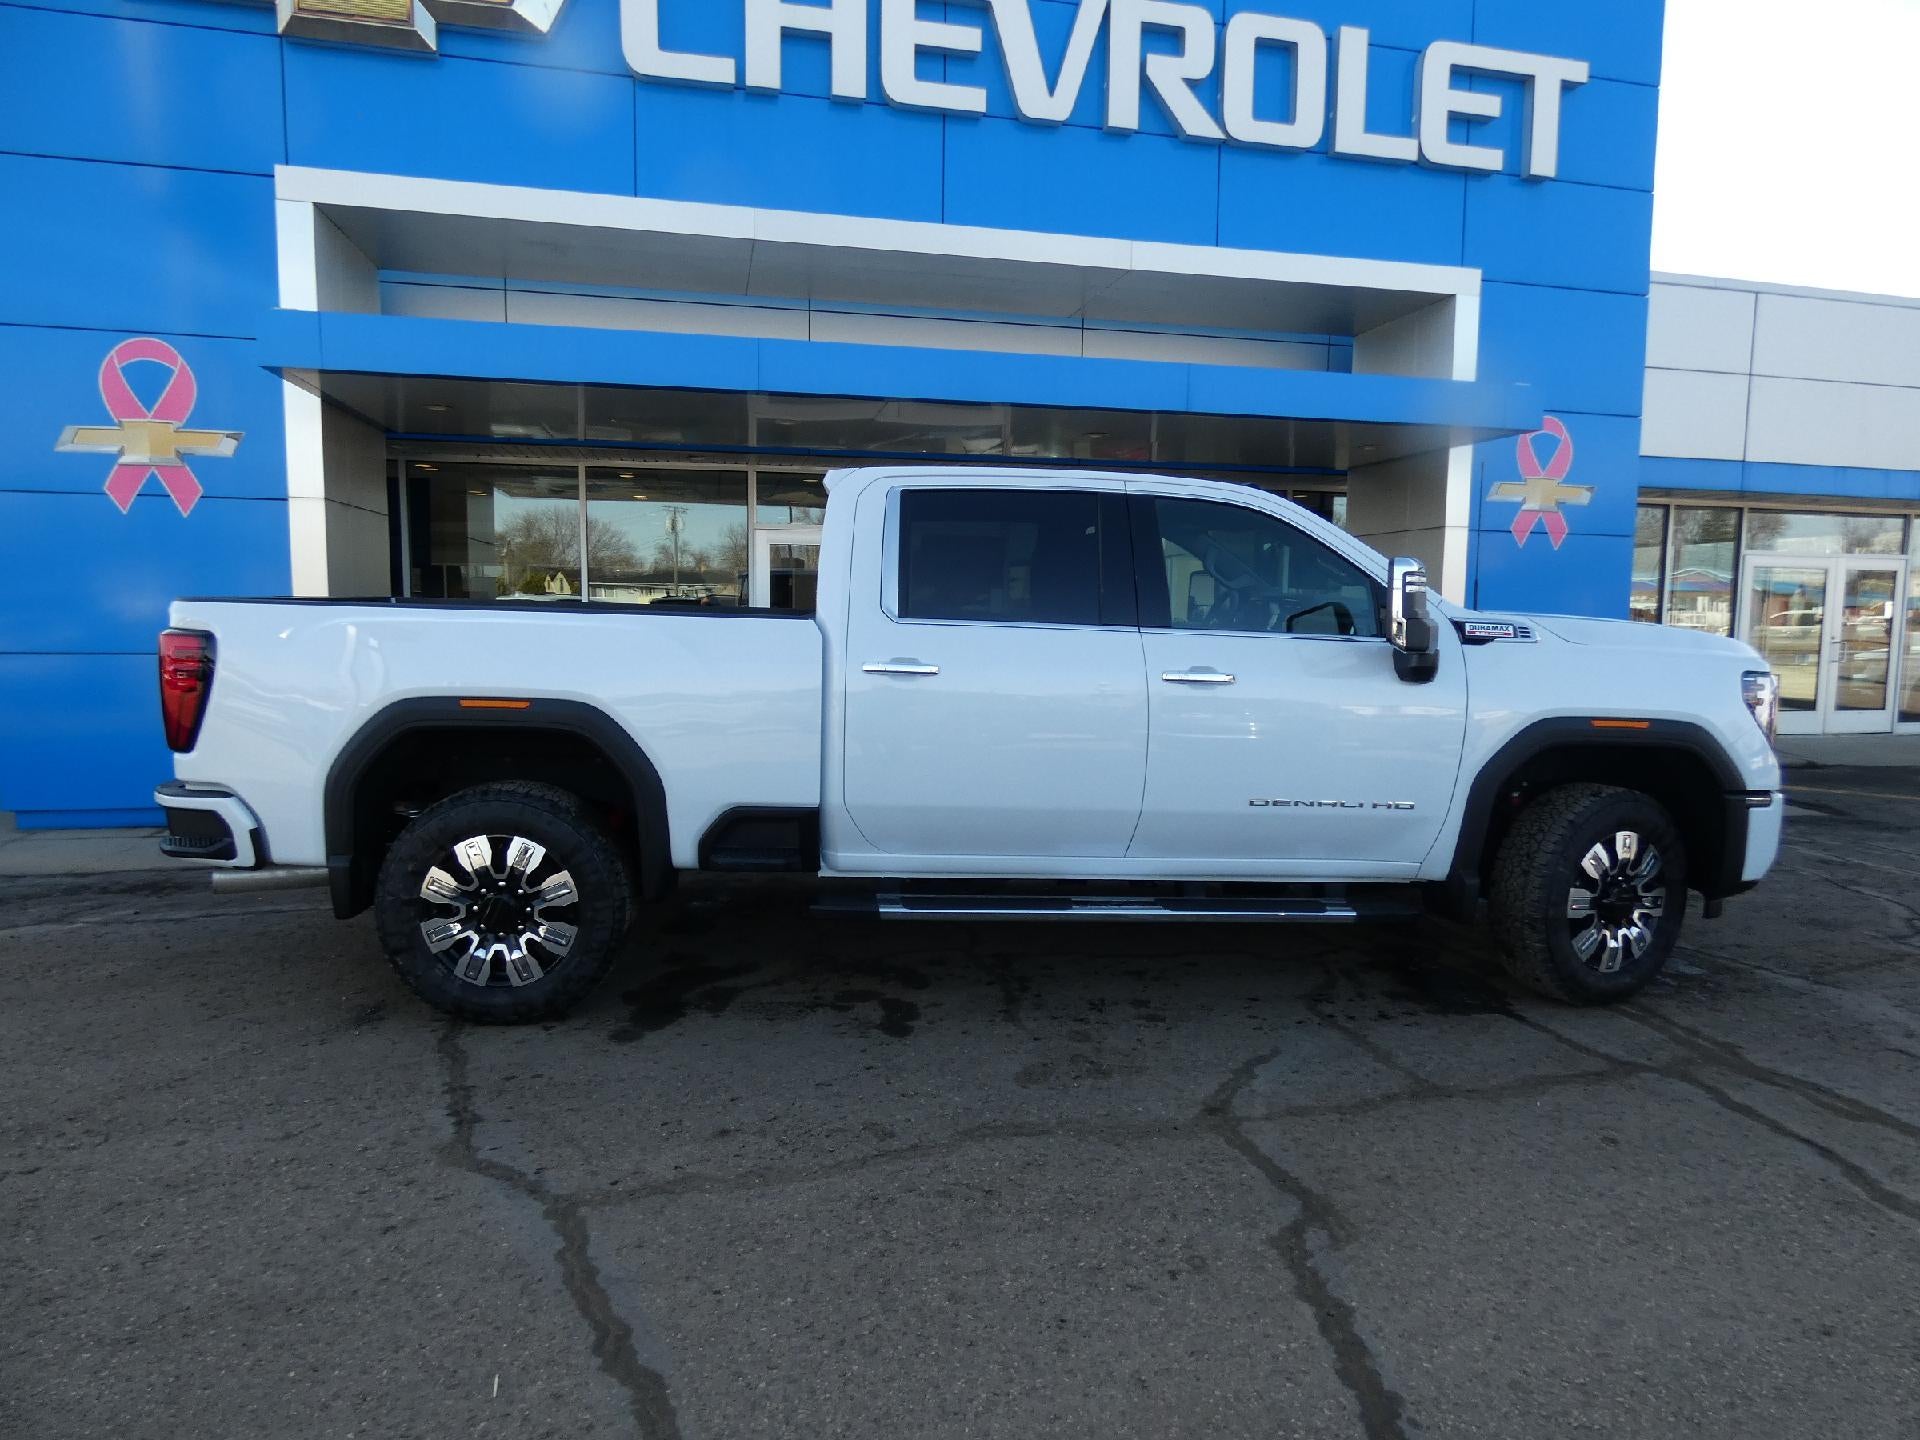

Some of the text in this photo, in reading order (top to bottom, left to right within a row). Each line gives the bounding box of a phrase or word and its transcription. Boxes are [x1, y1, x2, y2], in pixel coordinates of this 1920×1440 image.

[620, 0, 1590, 180] CHEVROLET
[1468, 624, 1511, 632] DURAMAX
[1248, 798, 1415, 810] DENALI HD
